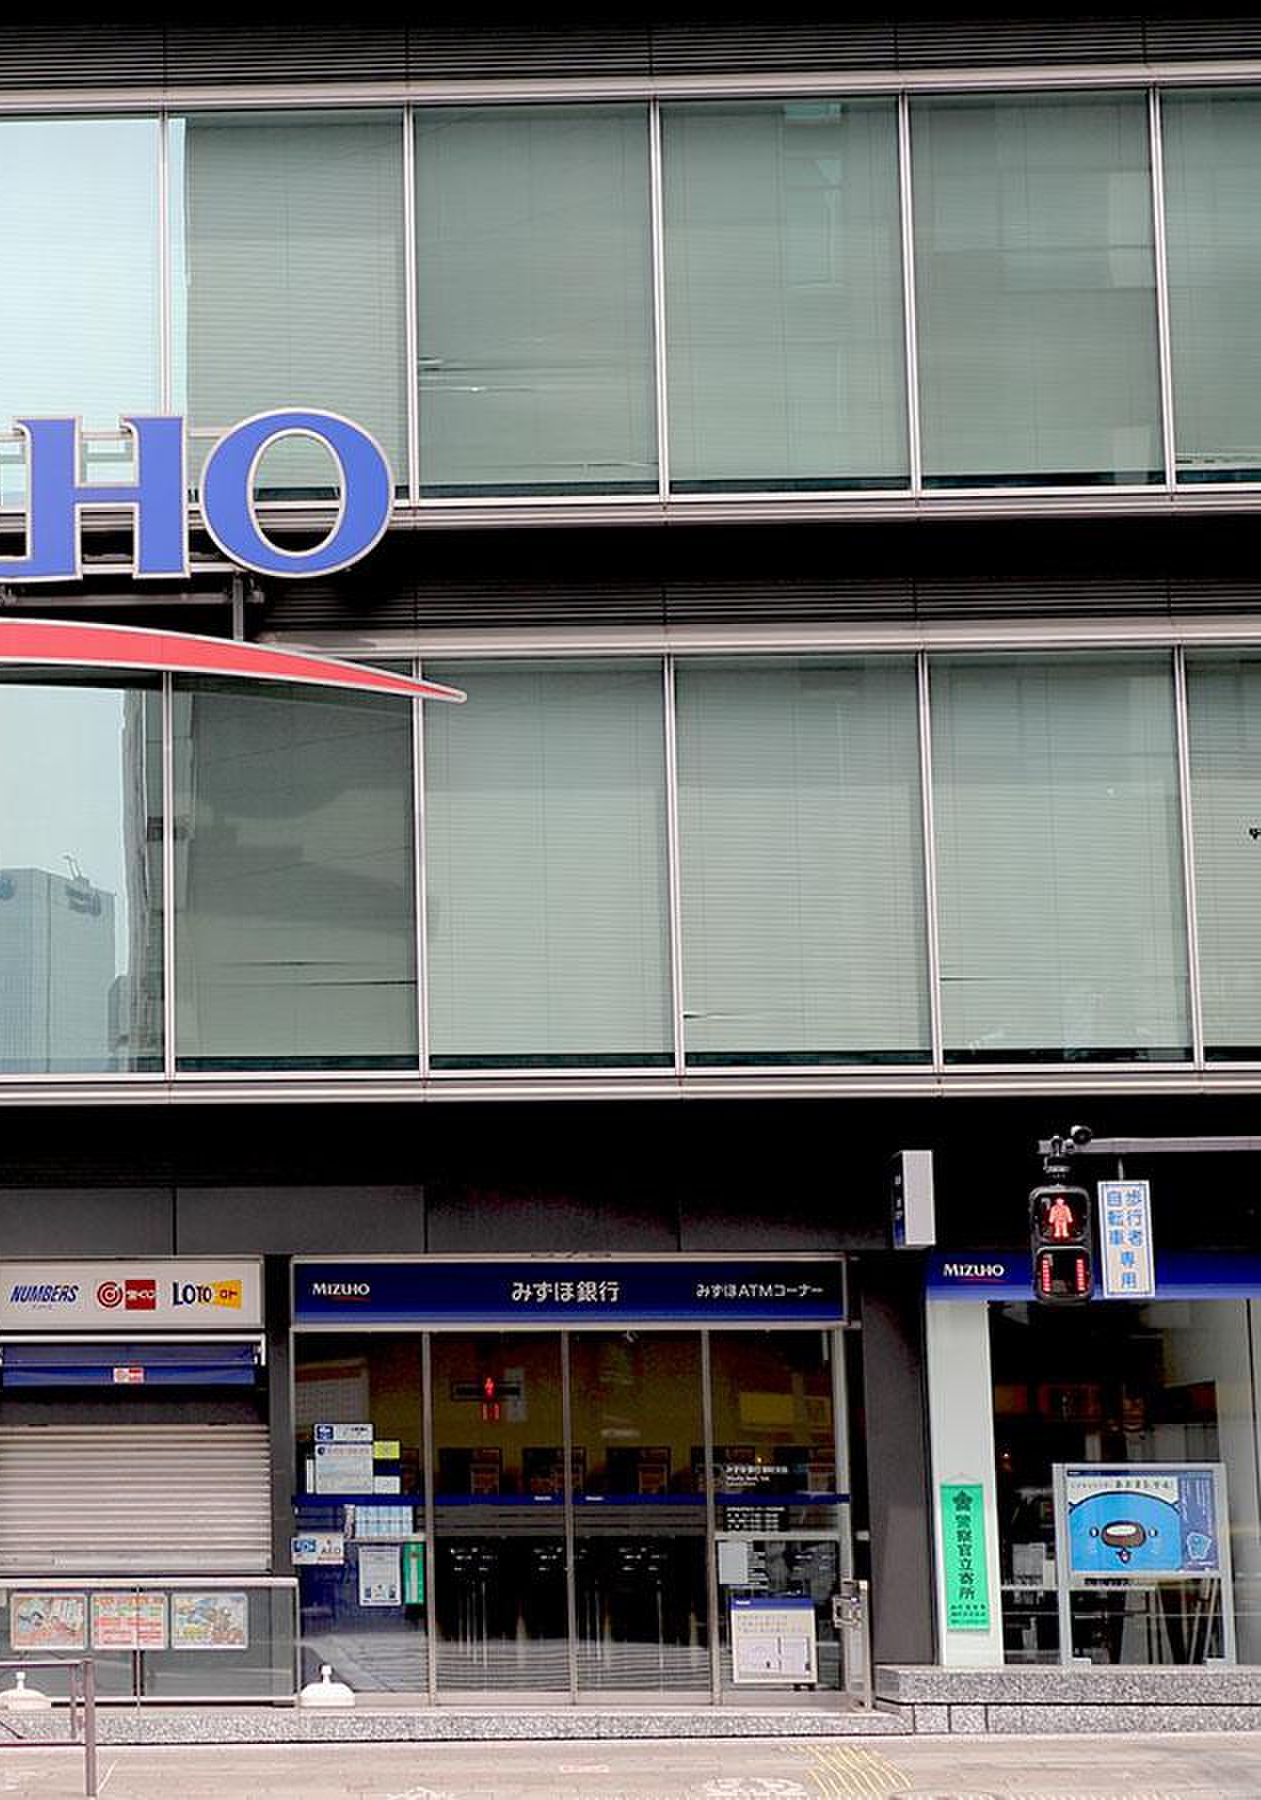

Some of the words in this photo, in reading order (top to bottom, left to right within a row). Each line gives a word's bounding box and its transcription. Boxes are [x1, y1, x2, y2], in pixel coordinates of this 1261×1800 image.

[943, 1264, 1005, 1276] MIZUHO
[10, 1285, 79, 1302] NUMBERS
[173, 1282, 212, 1306] LOTO
[312, 1281, 371, 1296] MIZUHO
[511, 1281, 620, 1302] みずほ銀行
[696, 1283, 824, 1297] みずほATMコーナー
